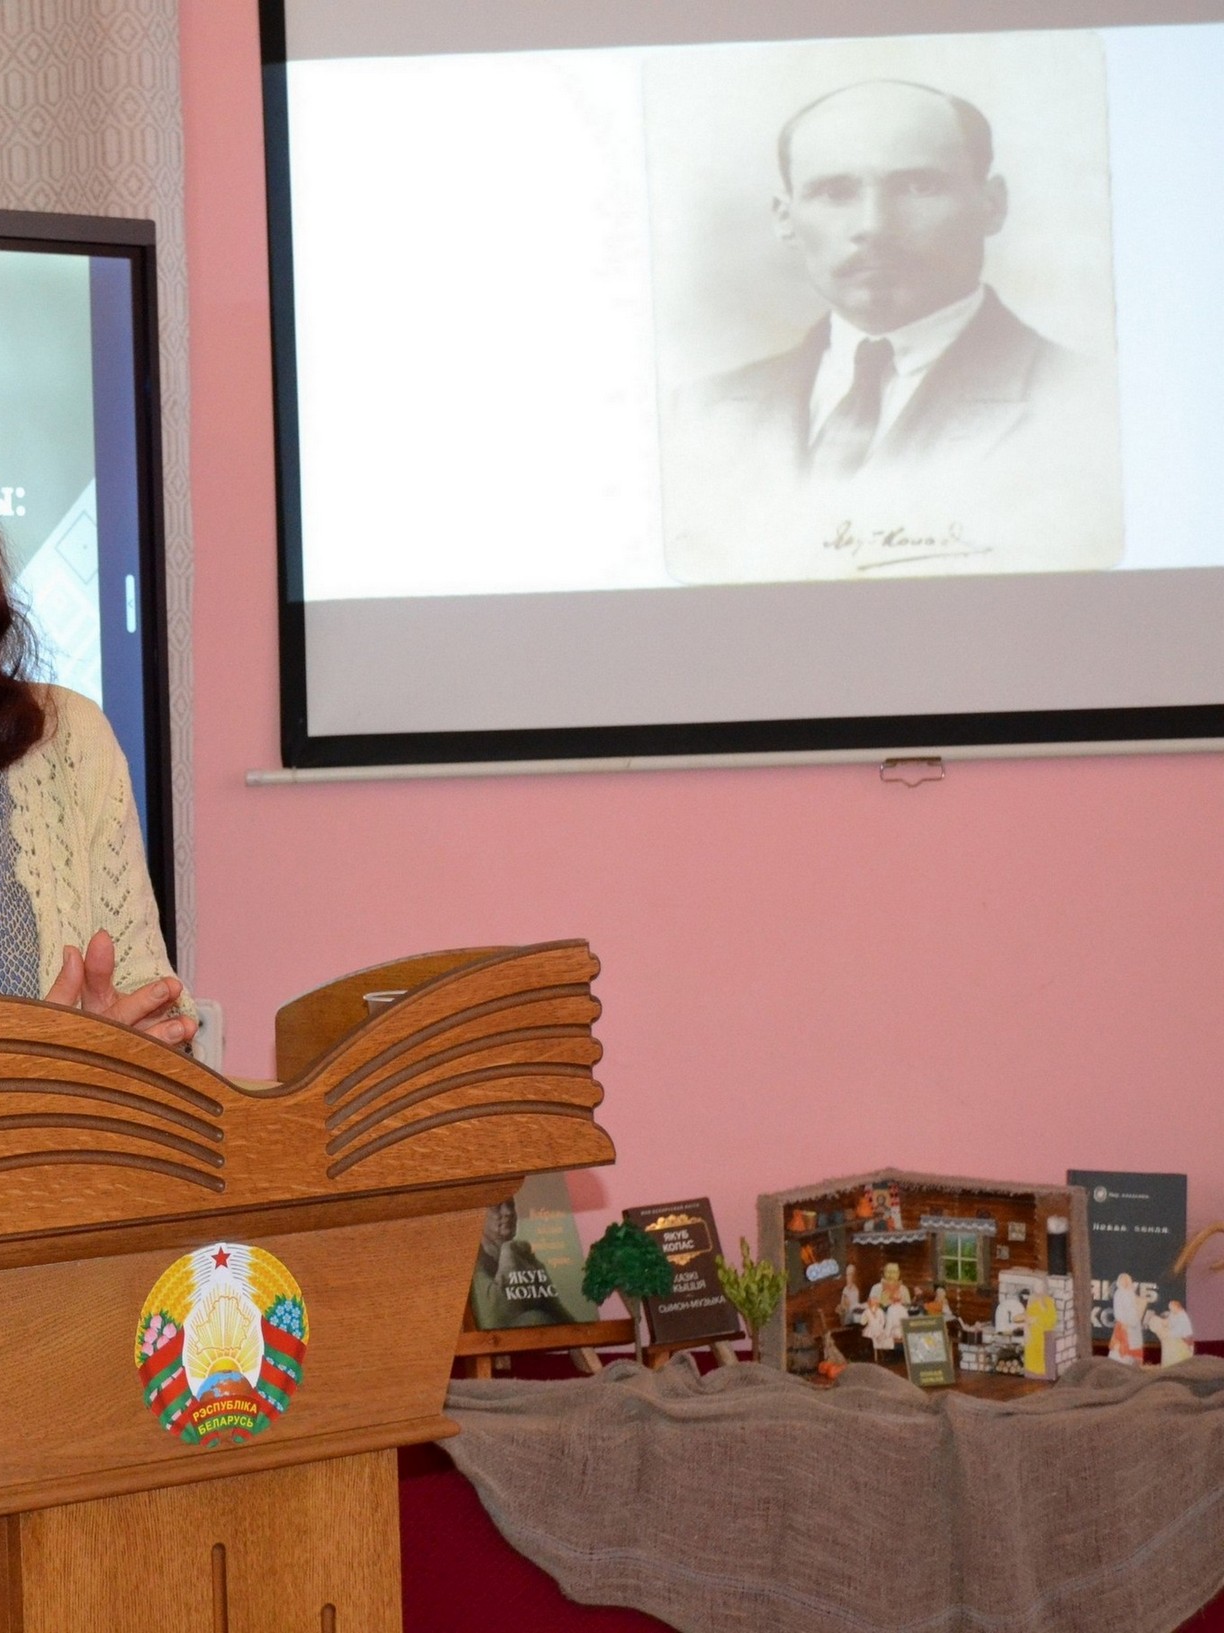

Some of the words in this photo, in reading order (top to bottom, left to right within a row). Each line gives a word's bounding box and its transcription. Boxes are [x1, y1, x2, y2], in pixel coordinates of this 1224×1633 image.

[663, 1229, 689, 1242] ЯКУБ
[662, 1240, 695, 1252] КОЛАС
[508, 1269, 548, 1284] ЯКУБ
[504, 1284, 559, 1300] КОЛАС
[192, 1400, 258, 1422] РЭСПУБЛІКА
[197, 1416, 254, 1435] БЕЛАРУСЬ
